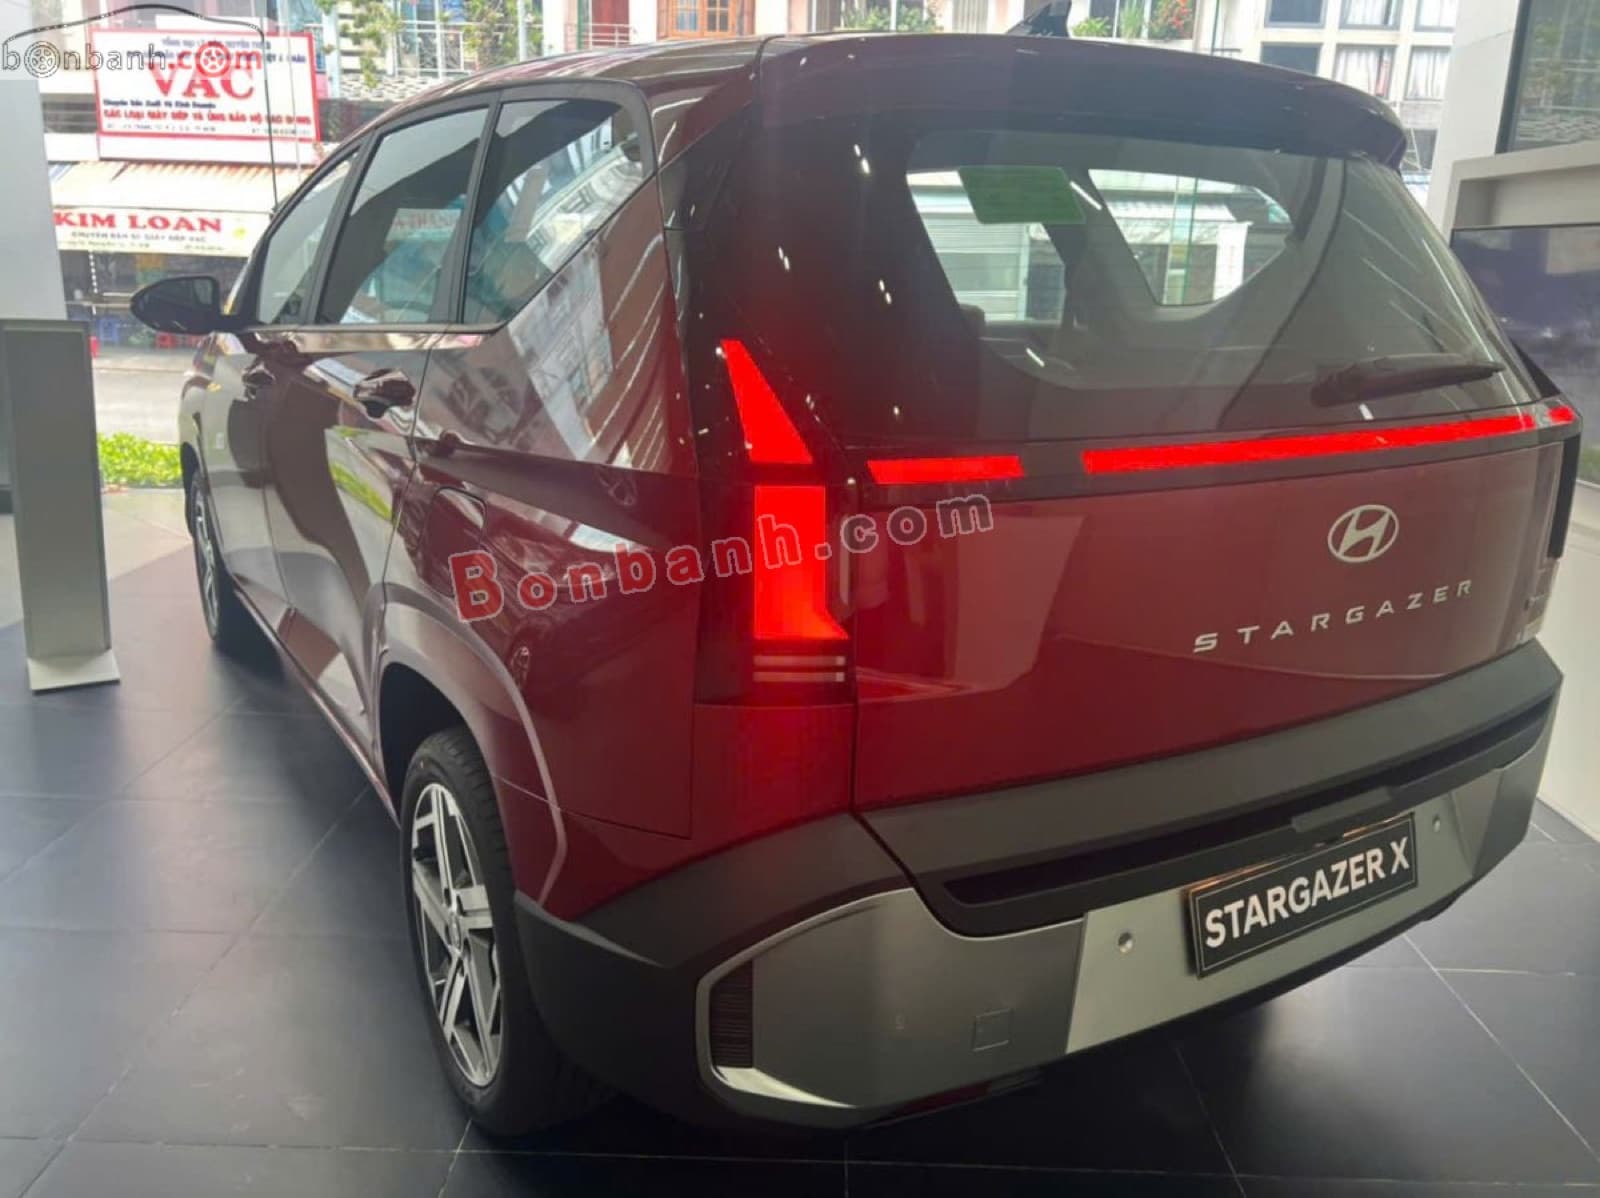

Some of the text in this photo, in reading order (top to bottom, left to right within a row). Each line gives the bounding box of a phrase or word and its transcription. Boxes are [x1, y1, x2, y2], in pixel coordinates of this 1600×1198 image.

[146, 62, 254, 99] VAC
[54, 211, 222, 233] KIM LOAN
[1193, 579, 1472, 653] STARGAZER
[1205, 836, 1411, 948] STARGAZER X
